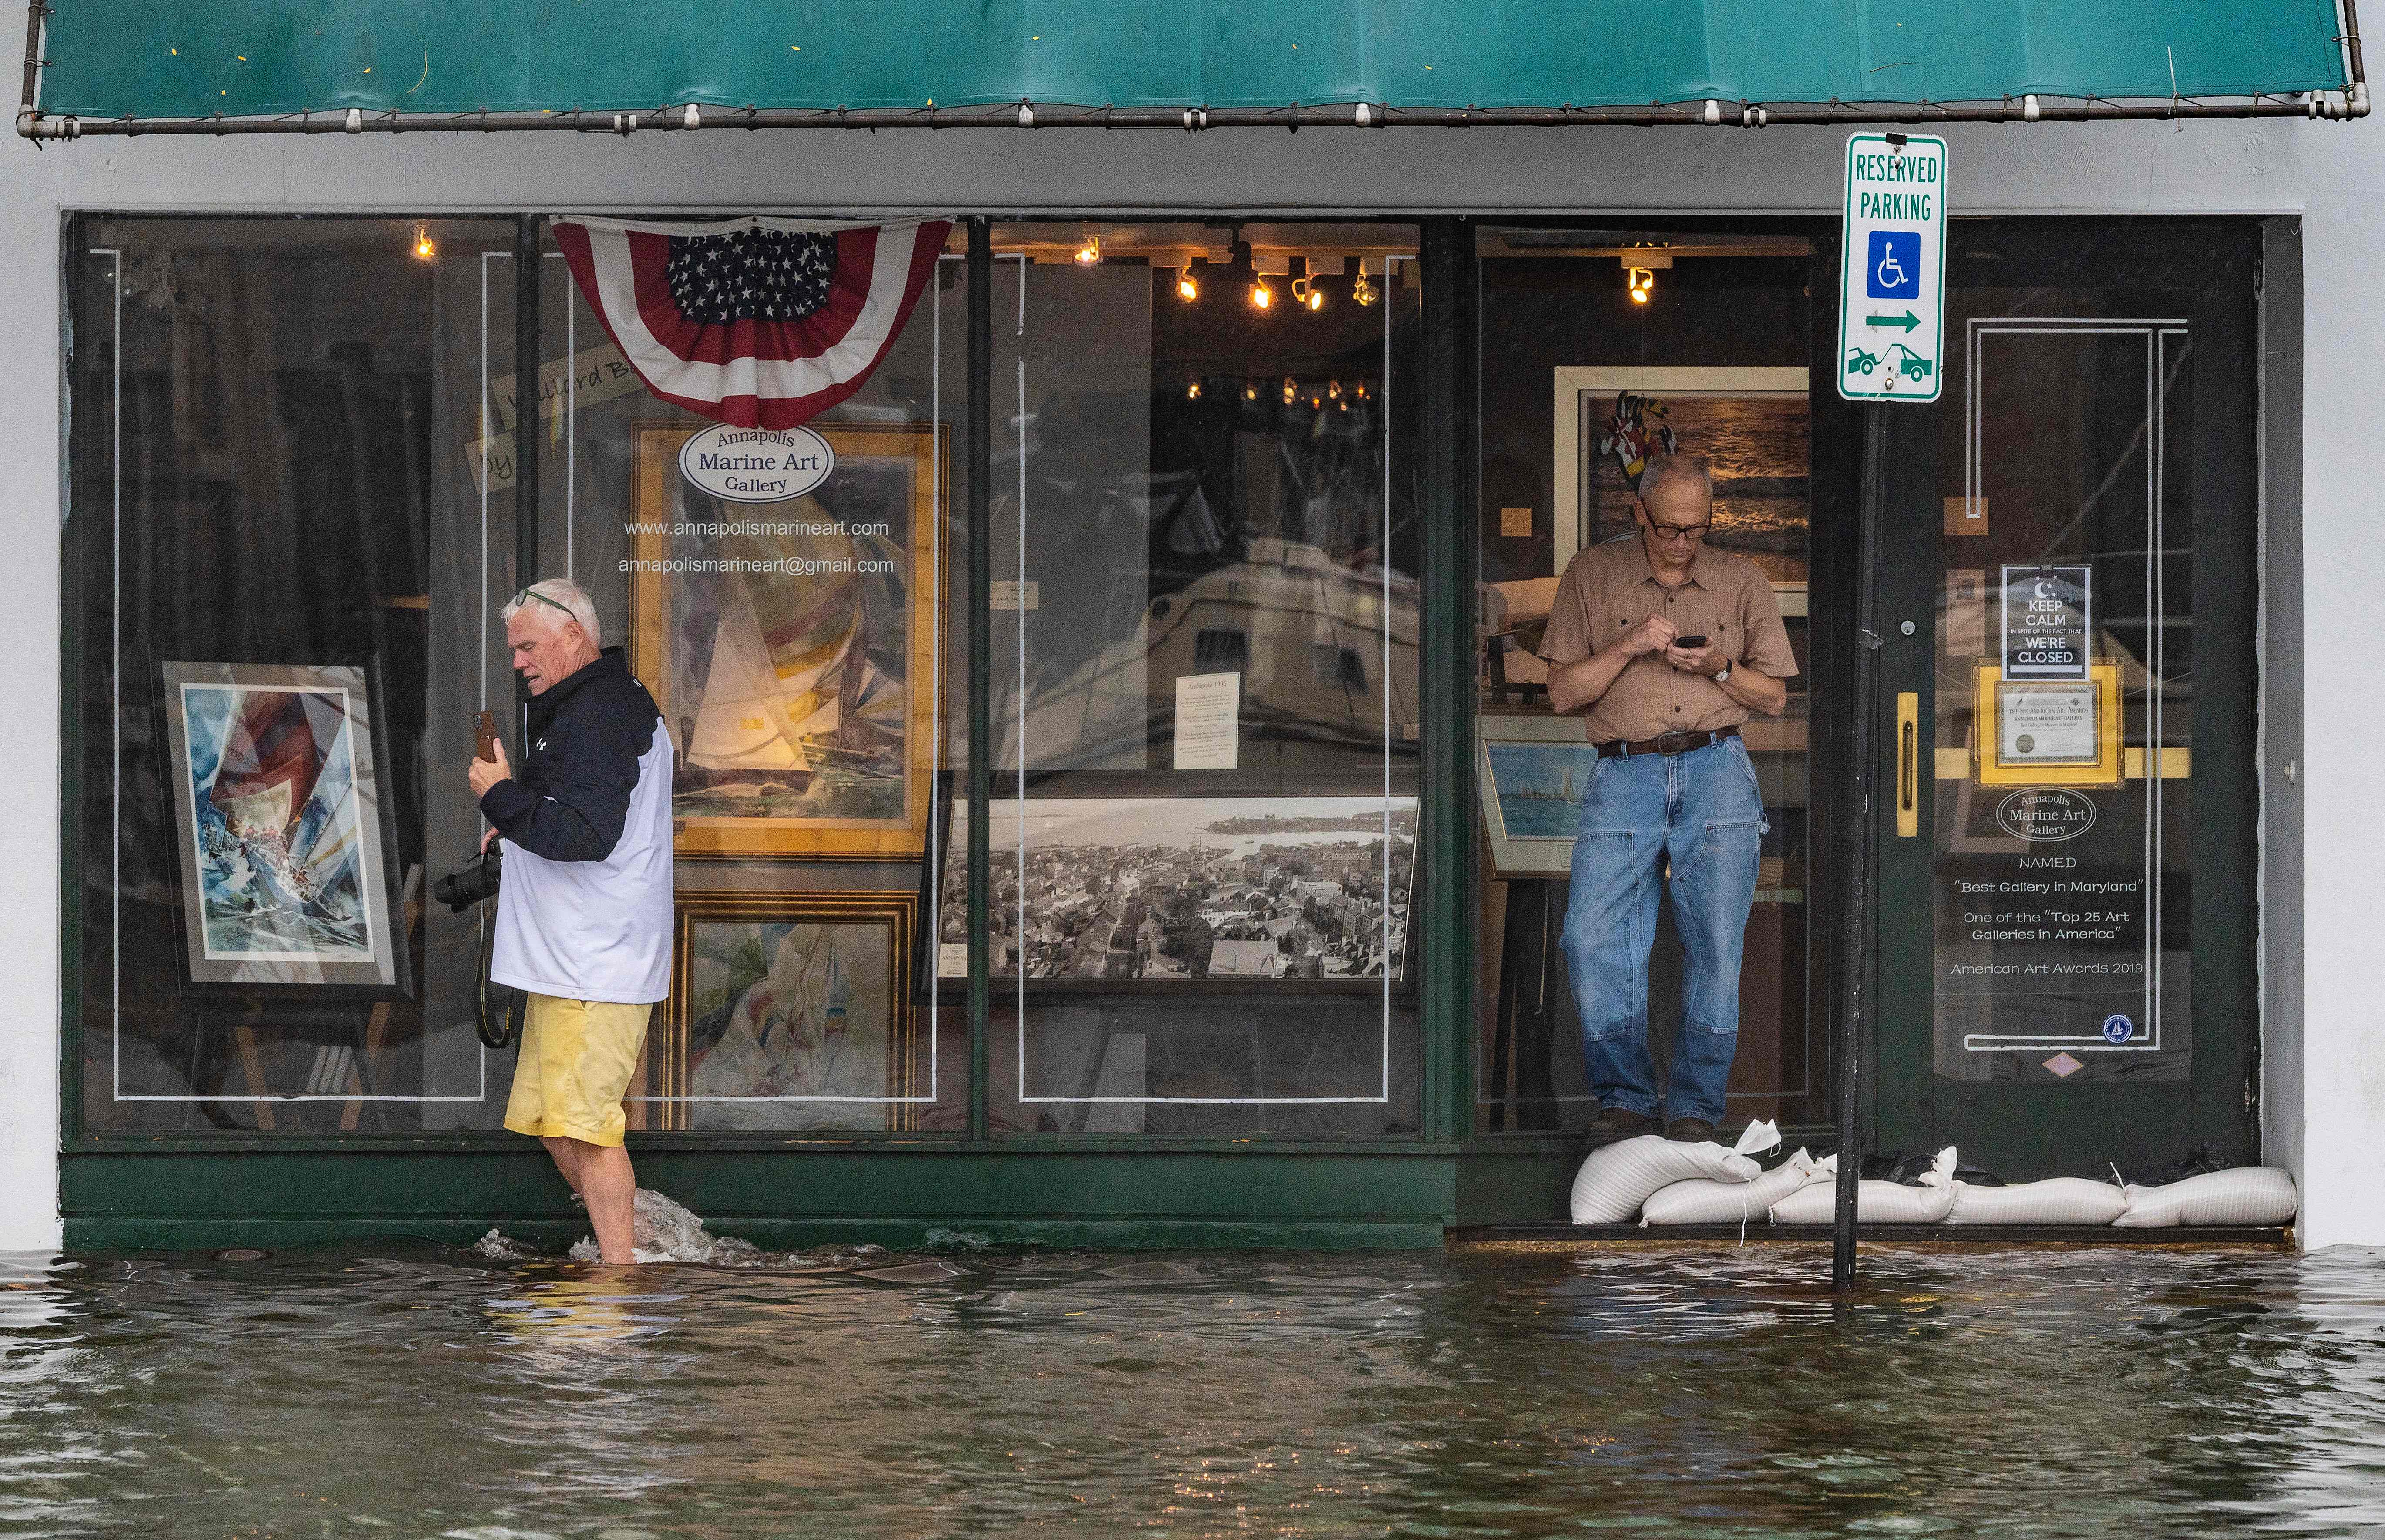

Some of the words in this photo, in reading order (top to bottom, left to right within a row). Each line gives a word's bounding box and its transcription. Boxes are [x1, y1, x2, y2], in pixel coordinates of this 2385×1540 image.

[1856, 154, 1937, 183] RESERVED
[1860, 192, 1931, 221] PARKING
[717, 431, 794, 447] Annapolis
[699, 453, 776, 470] Marine
[782, 453, 819, 470] Art
[725, 476, 787, 493] Gallery
[624, 520, 889, 538] www.annapolismarineart.com
[618, 557, 894, 576] annapolismarineart@gmail.com
[2029, 600, 2063, 612] KEEP
[2025, 615, 2066, 626] CALM
[2025, 637, 2066, 649] WE'RE
[2018, 652, 2074, 663] CLOSED
[2022, 795, 2070, 806] Annapolis
[2010, 810, 2059, 820] Marine
[2062, 809, 2086, 820] Art
[2026, 824, 2065, 835] Gallery
[2019, 857, 2076, 868] NAMED
[1955, 880, 1995, 893] "Best
[2000, 881, 2049, 894] Gallery
[2055, 881, 2066, 892] in
[2070, 878, 2143, 894] Maryland"
[1964, 912, 1992, 923] One
[1996, 912, 2012, 923] of
[2016, 912, 2041, 922] the
[2045, 909, 2080, 924] "Top
[2084, 912, 2101, 922] 25
[2105, 911, 2130, 922] Art
[1972, 928, 2035, 940] Galleries
[2039, 928, 2051, 939] in
[2055, 926, 2121, 939] America"
[1951, 963, 2020, 975] American
[2024, 963, 2049, 974] Art
[2052, 962, 2109, 973] Awards
[2113, 962, 2143, 974] 2019
